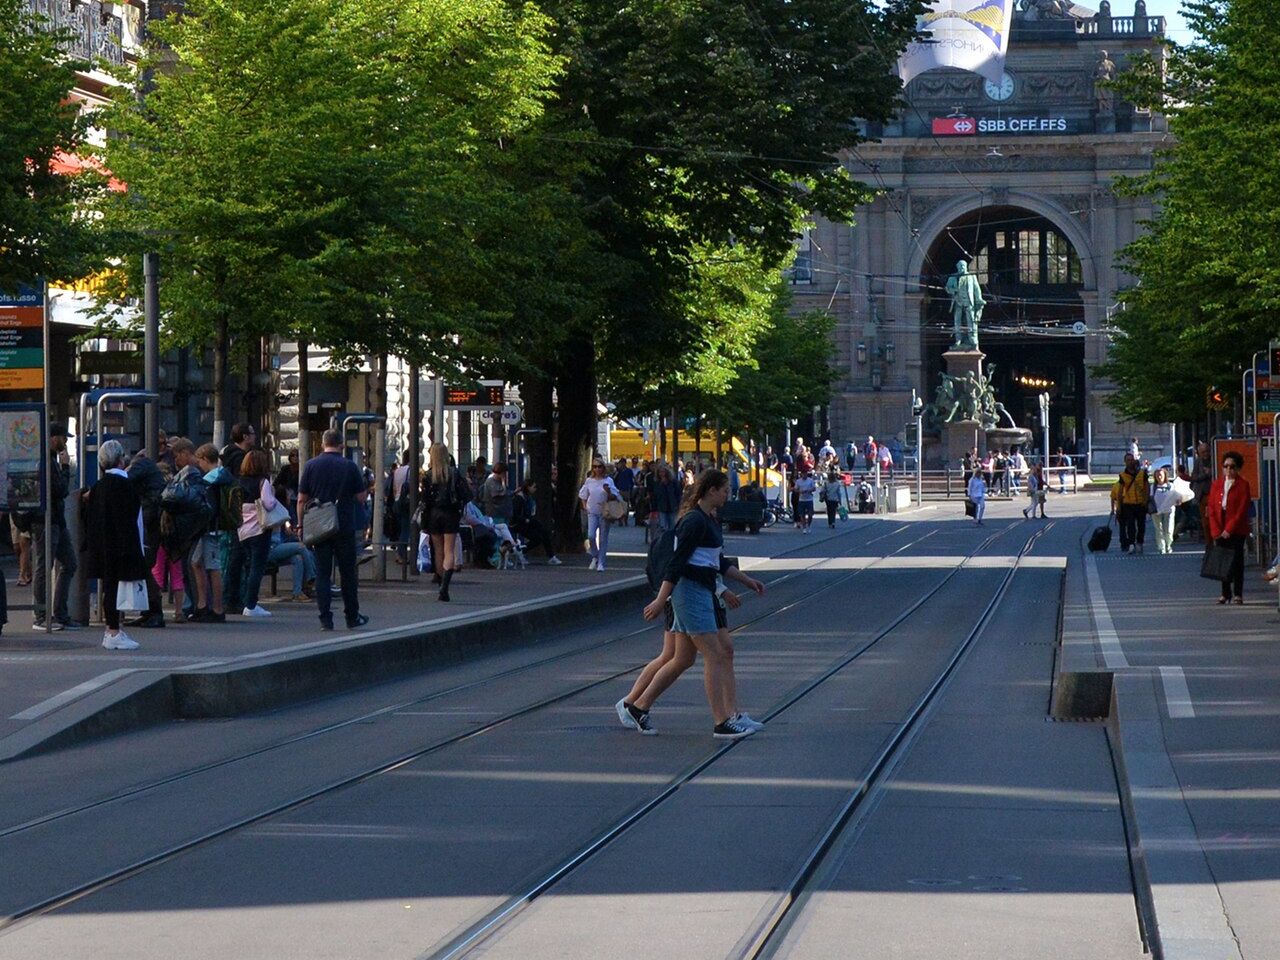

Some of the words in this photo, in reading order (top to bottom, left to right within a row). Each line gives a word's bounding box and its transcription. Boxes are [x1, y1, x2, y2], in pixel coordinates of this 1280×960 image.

[978, 119, 1006, 131] SBB
[1009, 119, 1037, 131] CFF
[1040, 118, 1067, 131] FFS
